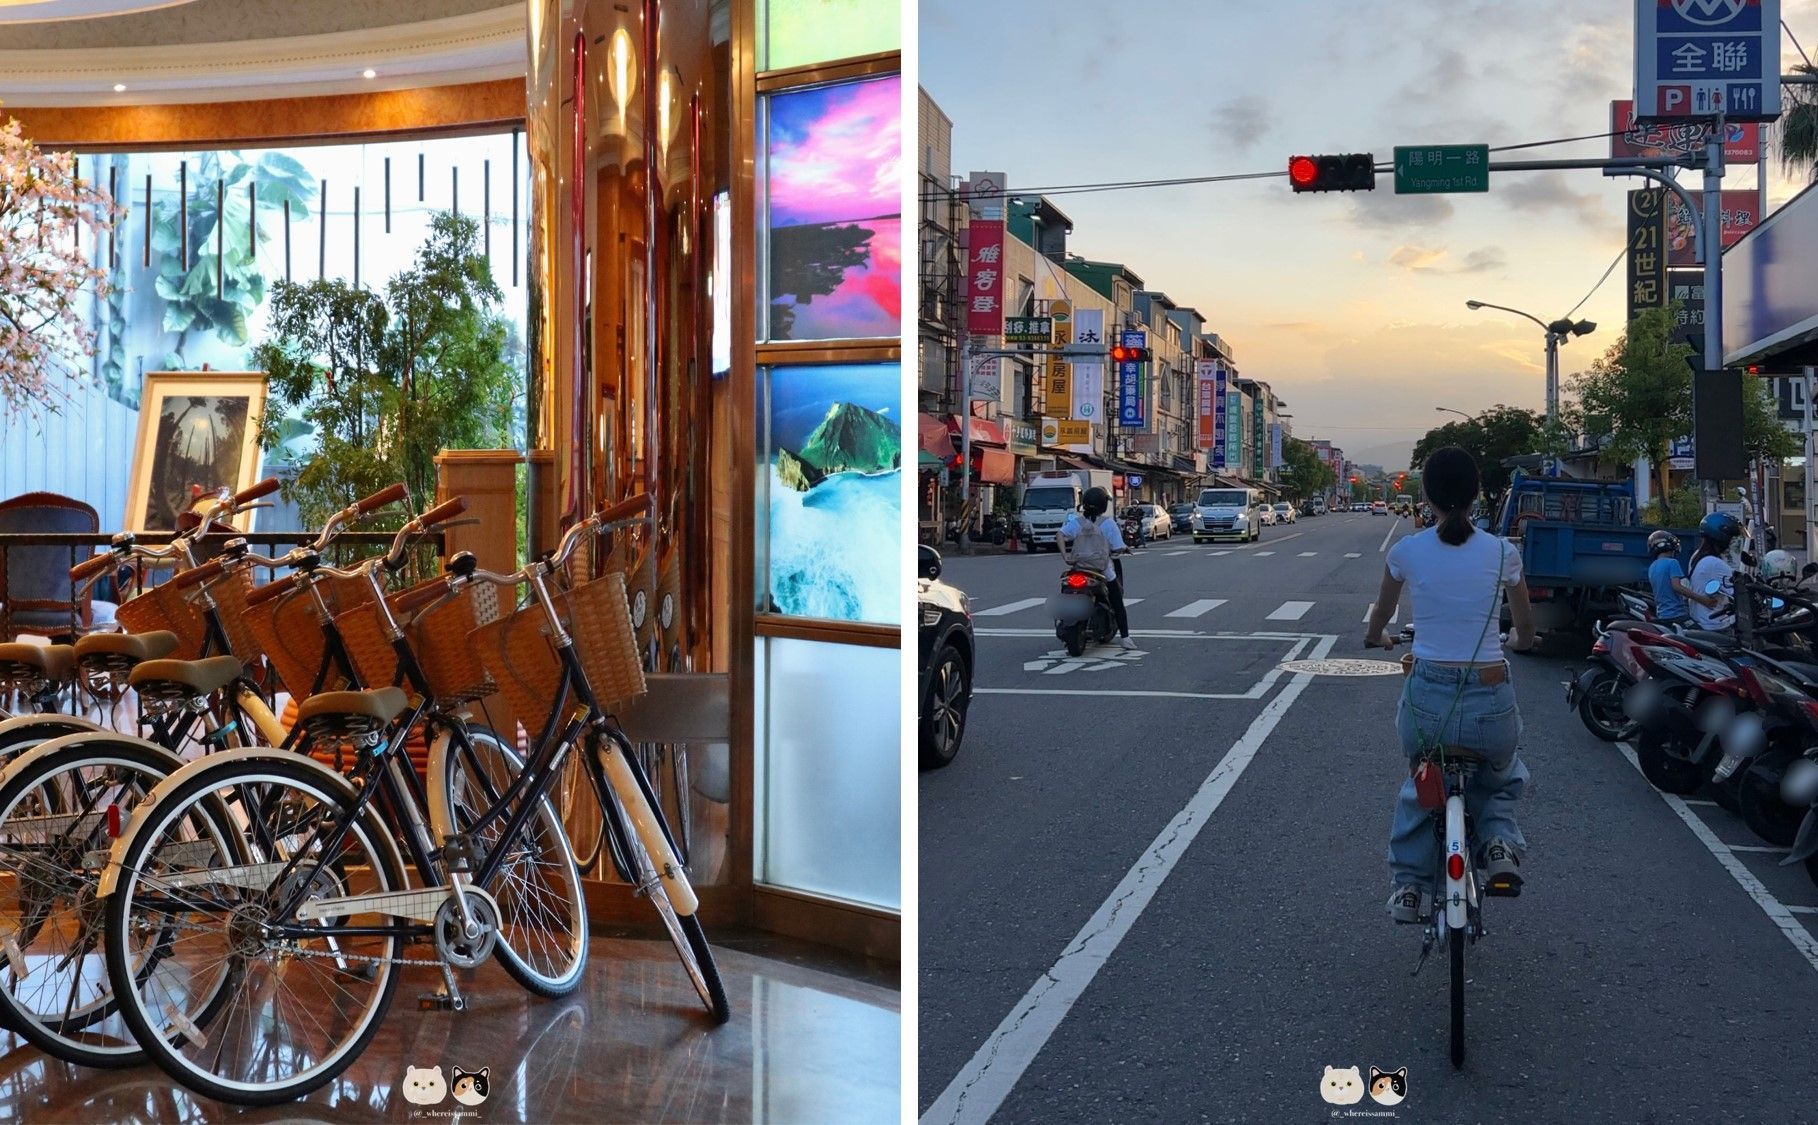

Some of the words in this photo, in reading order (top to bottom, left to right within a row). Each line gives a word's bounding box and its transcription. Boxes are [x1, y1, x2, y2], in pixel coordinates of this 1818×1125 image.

[1671, 41, 1748, 72] 全聯
[1665, 89, 1683, 111] P
[1408, 150, 1480, 166] 陽明一路
[1411, 177, 1451, 190] Yangming
[1453, 176, 1464, 187] 1st
[1451, 841, 1460, 851] 5
